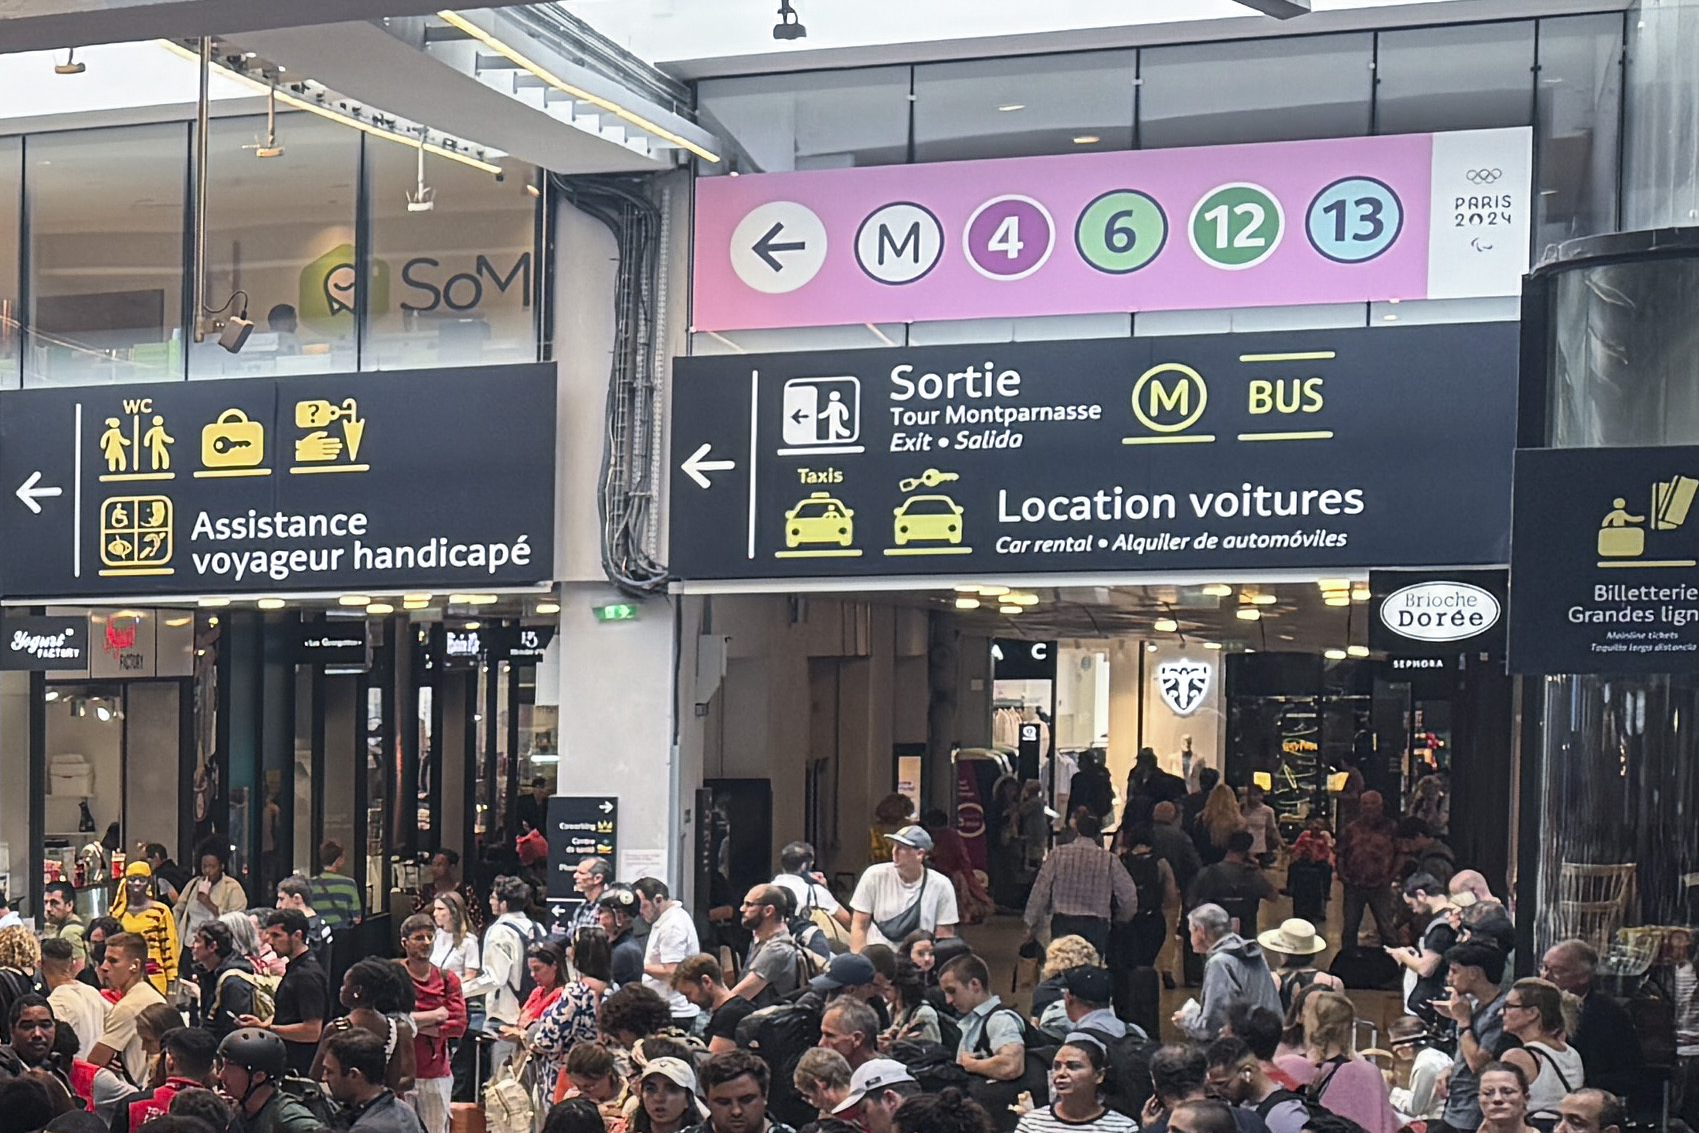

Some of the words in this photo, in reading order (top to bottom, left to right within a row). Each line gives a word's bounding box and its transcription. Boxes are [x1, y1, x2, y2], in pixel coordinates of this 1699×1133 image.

[1454, 194, 1512, 211] PARIS
[987, 215, 1024, 260] 4
[1103, 208, 1137, 254] 6
[1203, 202, 1267, 249] 12
[1322, 196, 1385, 243] 13
[1454, 211, 1512, 228] 2024
[889, 361, 1021, 401] Sortie
[1248, 376, 1325, 415] BUS
[122, 398, 153, 415] WC
[890, 406, 939, 426] Tour
[946, 403, 1102, 427] Montparnasse
[890, 430, 933, 452] Exit
[954, 429, 1024, 451] Salida
[797, 467, 844, 485] Taxis
[998, 486, 1176, 523] Location
[1190, 482, 1365, 519] voitures
[191, 510, 368, 541] Assistance
[995, 535, 1030, 554] Car
[1034, 534, 1093, 552] rental
[1111, 532, 1190, 555] Alquiler
[1193, 532, 1218, 550] de
[1222, 529, 1348, 550] automóviles
[192, 547, 344, 581] voyageur
[354, 535, 532, 574] handicapé
[1405, 591, 1478, 608] Brioche
[1594, 583, 1699, 602] Billetterie
[1398, 608, 1484, 627] Dorée
[1568, 606, 1655, 623] Grandes
[1393, 659, 1444, 669] SEPHORA
